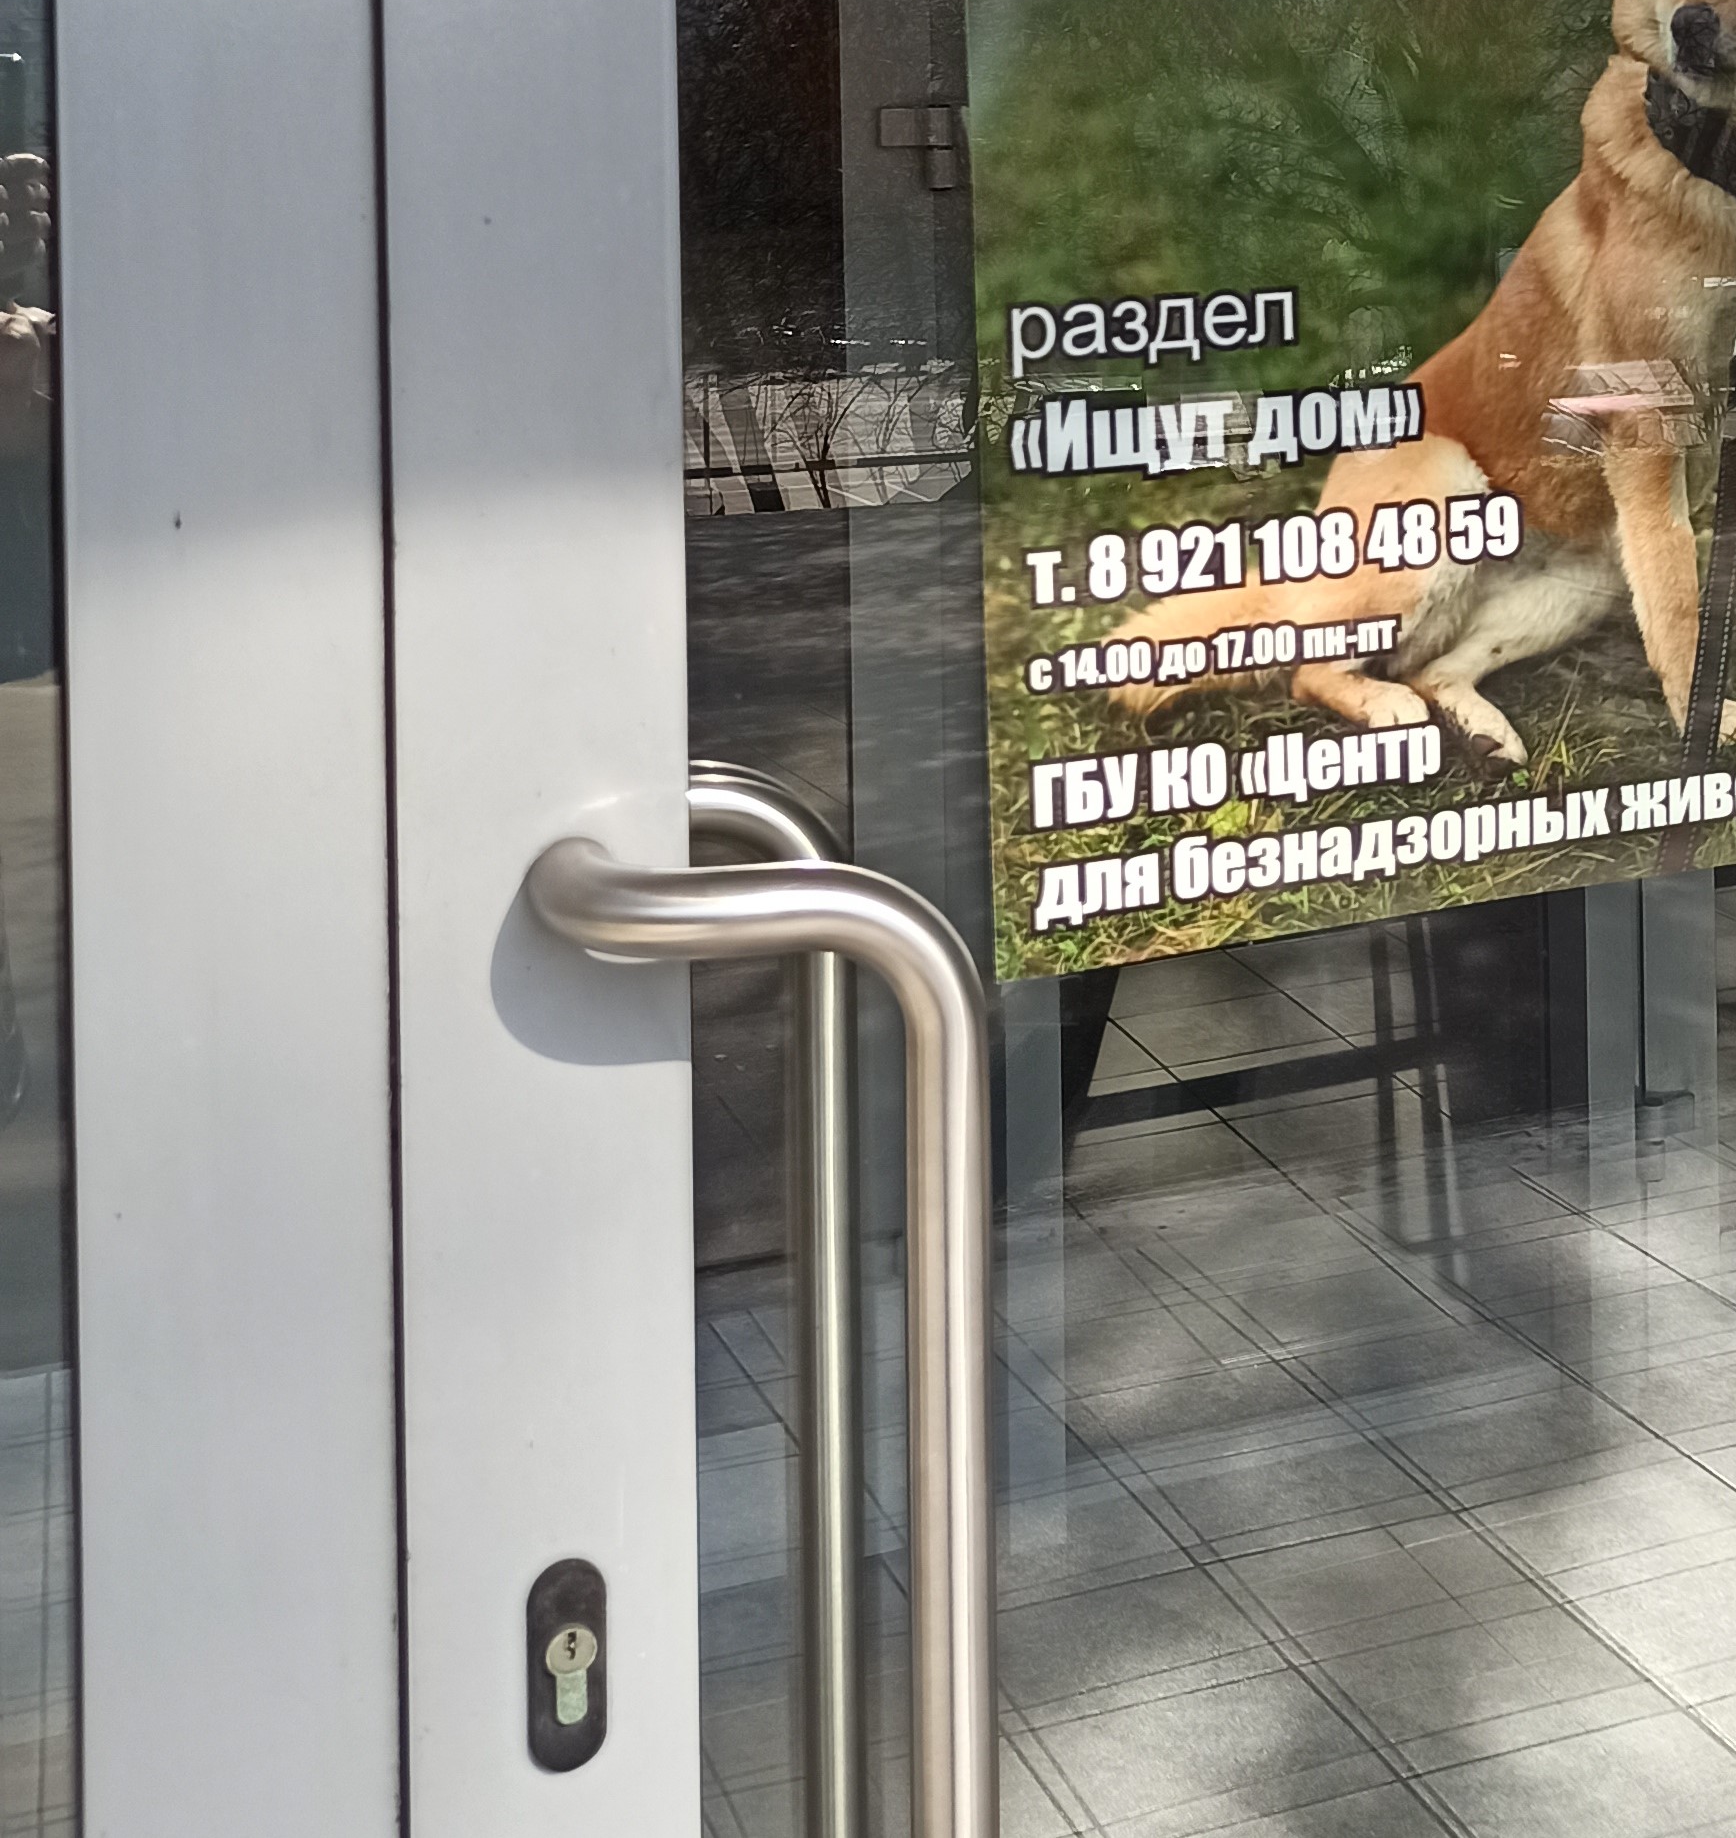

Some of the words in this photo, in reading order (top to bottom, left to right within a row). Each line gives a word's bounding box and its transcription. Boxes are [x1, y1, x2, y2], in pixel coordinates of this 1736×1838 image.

[1011, 292, 1293, 376] раздел
[1010, 400, 1236, 473] «Ищут
[1247, 388, 1422, 462] дом»
[1026, 550, 1076, 605] т.
[1089, 533, 1126, 599] 8
[1140, 524, 1243, 593] 921
[1254, 510, 1354, 580] 108
[1366, 503, 1439, 566] 48
[1449, 495, 1522, 561] 59
[1029, 666, 1053, 692] с
[1061, 646, 1153, 688] 14.00
[1157, 645, 1206, 682] до
[1212, 623, 1296, 670] 17.00
[1302, 618, 1398, 659] пн-пт
[1032, 757, 1141, 829] ГБУ
[1151, 741, 1227, 815] КО
[1238, 722, 1442, 805] «Центр
[1035, 855, 1159, 928] для
[1176, 794, 1610, 899] безнадзорных
